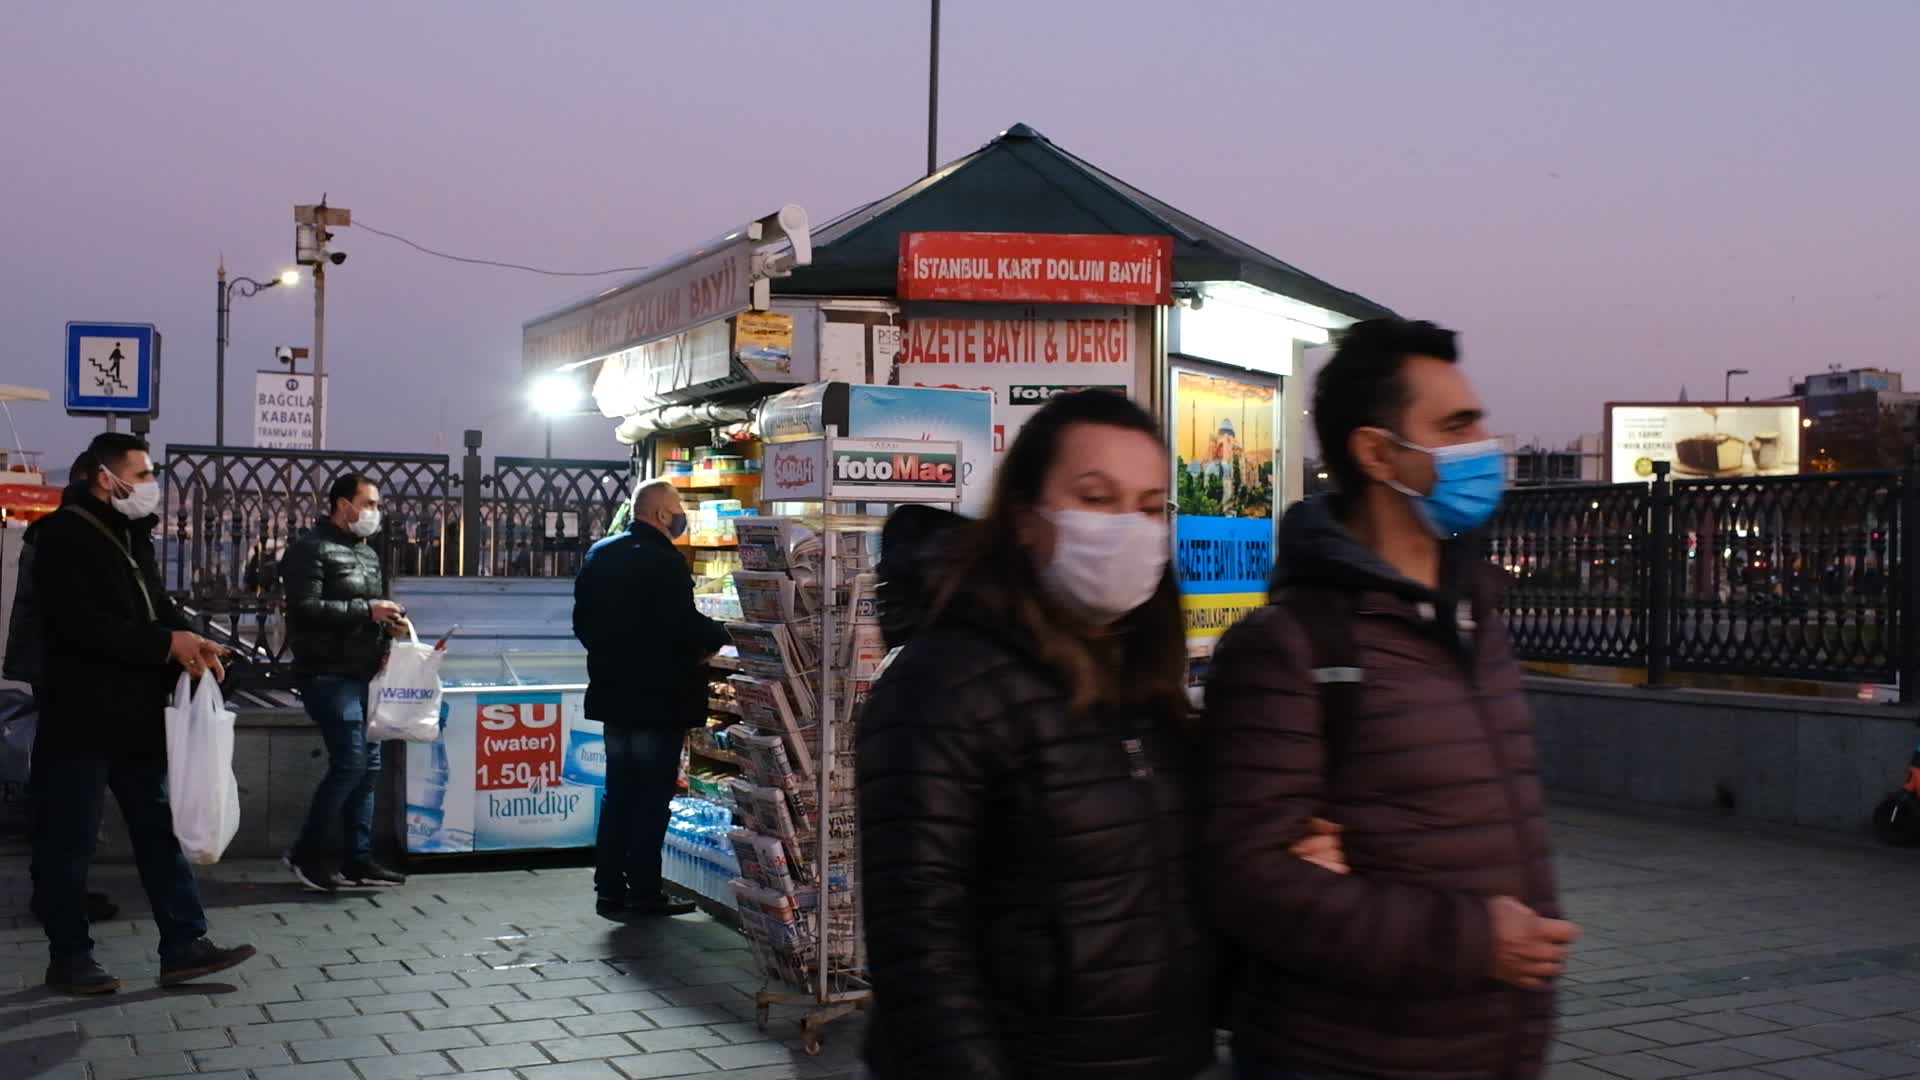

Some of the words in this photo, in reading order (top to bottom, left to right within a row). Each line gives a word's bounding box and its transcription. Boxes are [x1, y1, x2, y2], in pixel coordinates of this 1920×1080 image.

[914, 253, 993, 279] İSTANBUL
[998, 257, 1042, 279] KART
[1047, 258, 1104, 282] DOLUM
[689, 256, 737, 316] BAYİİ
[899, 318, 976, 364] GAZETE
[983, 308, 1036, 364] BAYİİ
[1044, 322, 1058, 364] &
[1066, 308, 1128, 364] DERGİ
[258, 391, 314, 407] BAĞCILA
[262, 410, 311, 424] KABATA
[481, 703, 558, 731] SU
[484, 732, 556, 757] (water)
[477, 762, 531, 786] 1.50
[488, 789, 580, 821] hamidiye
